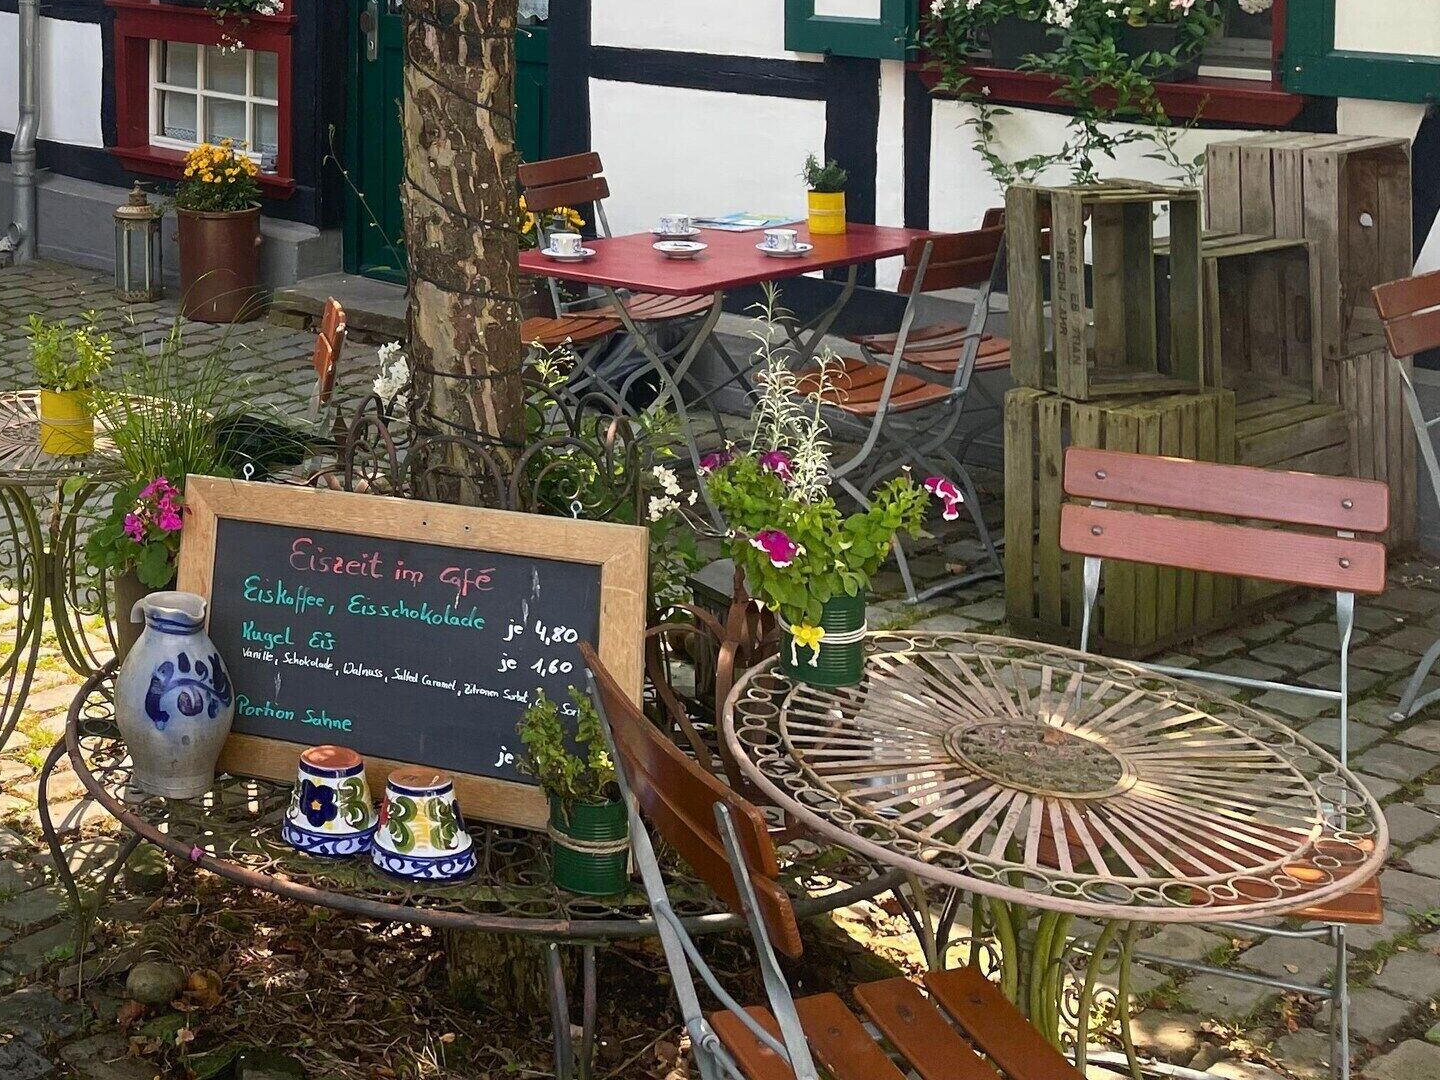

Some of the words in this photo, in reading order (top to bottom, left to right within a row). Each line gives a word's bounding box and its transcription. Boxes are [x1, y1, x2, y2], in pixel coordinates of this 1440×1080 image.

[289, 537, 384, 579] Eiszeit
[394, 560, 424, 587] im
[439, 566, 497, 598] Café
[241, 620, 295, 650] Kugel
[308, 630, 337, 651] Eis
[497, 652, 518, 673] je
[530, 657, 573, 678] 1,60
[502, 618, 524, 643] je
[534, 619, 579, 646] 4,80
[242, 647, 279, 666] Vanille,
[282, 651, 339, 677] Schokolade,
[343, 662, 389, 683] Walnuss,
[391, 666, 418, 684] Salted
[421, 674, 461, 696] Caramel,
[463, 683, 500, 698] Zitronen
[502, 689, 532, 709] Sorbet,
[235, 694, 295, 720] Portion
[300, 709, 353, 733] Sahne
[494, 745, 515, 768] je
